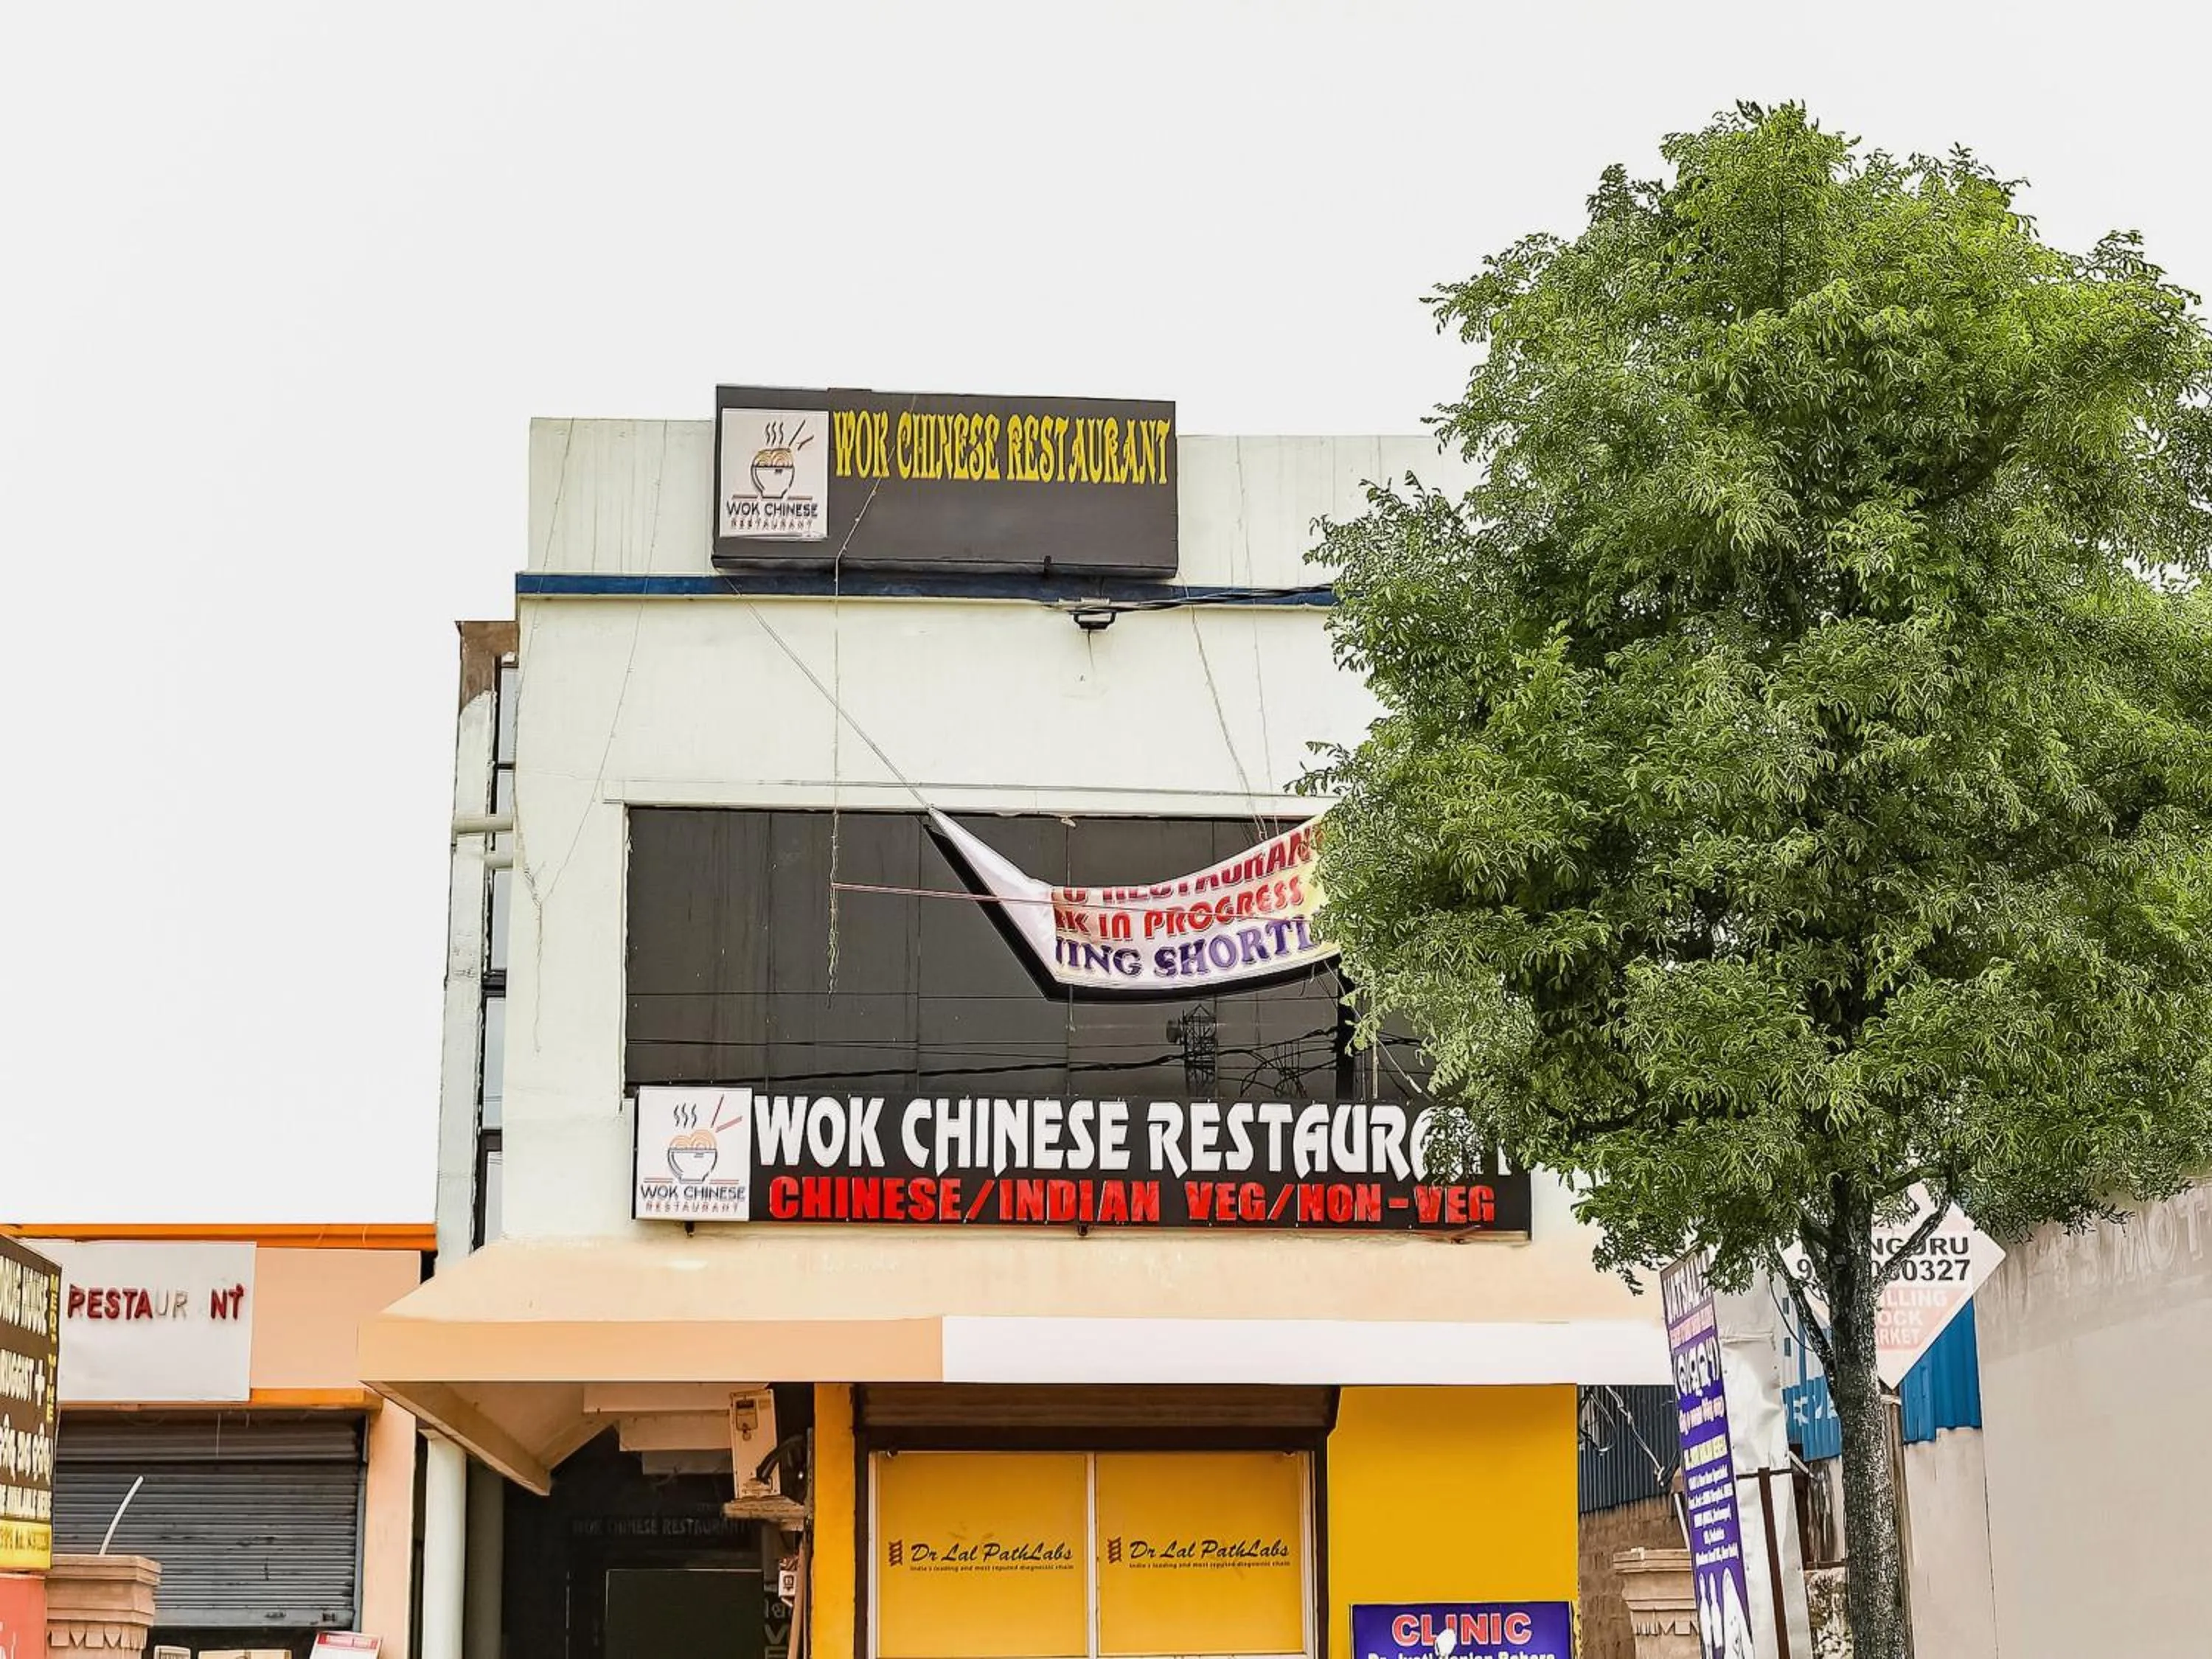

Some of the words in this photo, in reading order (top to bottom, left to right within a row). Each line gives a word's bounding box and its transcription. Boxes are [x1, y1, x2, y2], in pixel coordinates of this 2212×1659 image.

[832, 410, 890, 478] WOK
[897, 411, 1001, 480] CHINESE
[1006, 414, 1172, 484] RESTAURANT
[726, 501, 760, 515] WOK
[764, 502, 818, 517] CHINESE
[1144, 875, 1304, 941] PROGRESS
[754, 1094, 886, 1168] WOK
[900, 1097, 1131, 1178] CHINESE
[1147, 1101, 1512, 1182] RESTAURA
[640, 1184, 678, 1199] WOK
[684, 1185, 746, 1202] CHINESE
[769, 1175, 1161, 1223] CHINESE/INDIAN
[911, 1543, 937, 1562] Dr
[941, 1543, 978, 1562] Lal
[983, 1541, 1074, 1562] PathLabs
[1129, 1540, 1156, 1559] Dr
[1160, 1540, 1197, 1559] Lal
[1200, 1538, 1290, 1559] PathLabs
